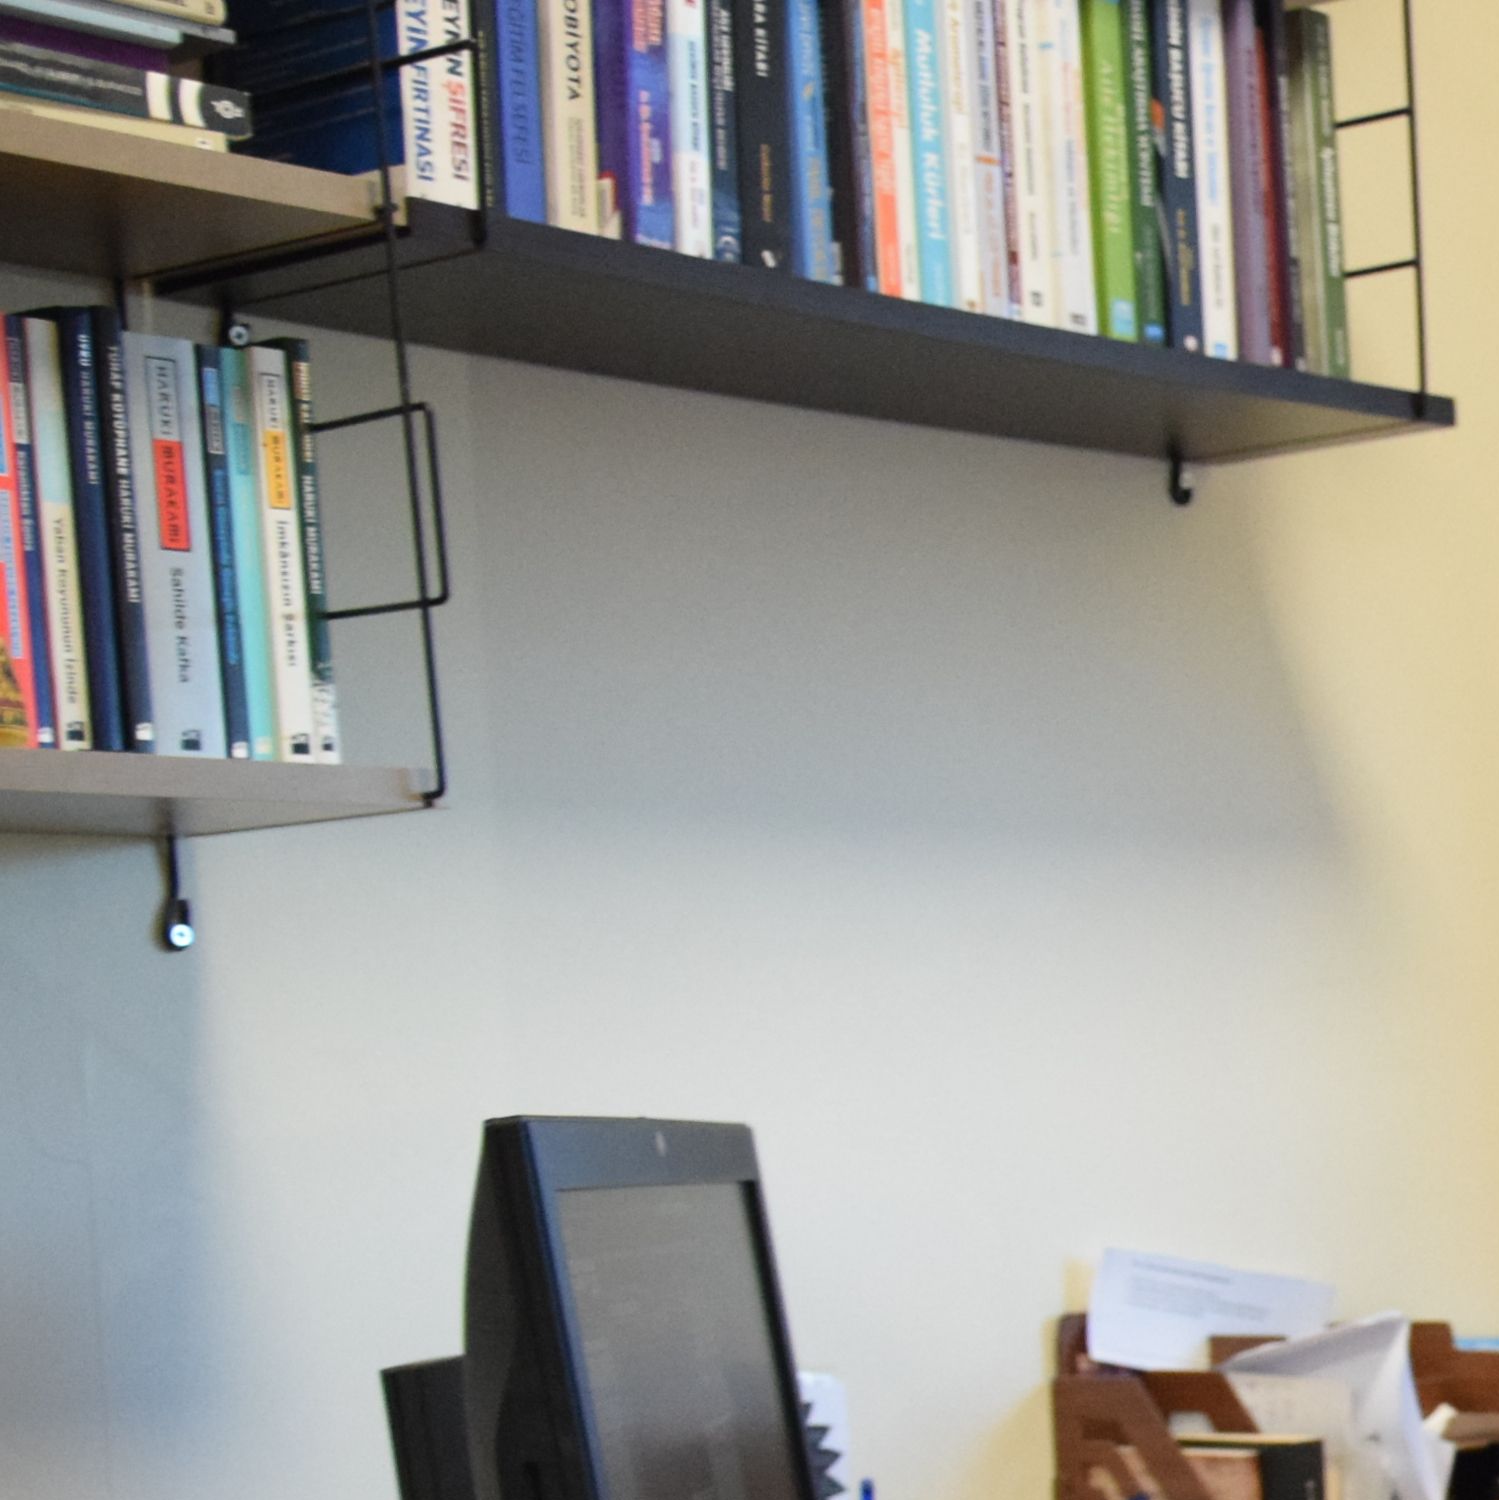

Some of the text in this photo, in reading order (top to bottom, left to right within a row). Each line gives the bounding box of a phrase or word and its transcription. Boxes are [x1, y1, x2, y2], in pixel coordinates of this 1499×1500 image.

[405, 0, 435, 182] YİN FIRTINASI
[441, 0, 471, 182] EYNN ŞİFRESİ
[170, 567, 192, 684] Sahilde Kafka
